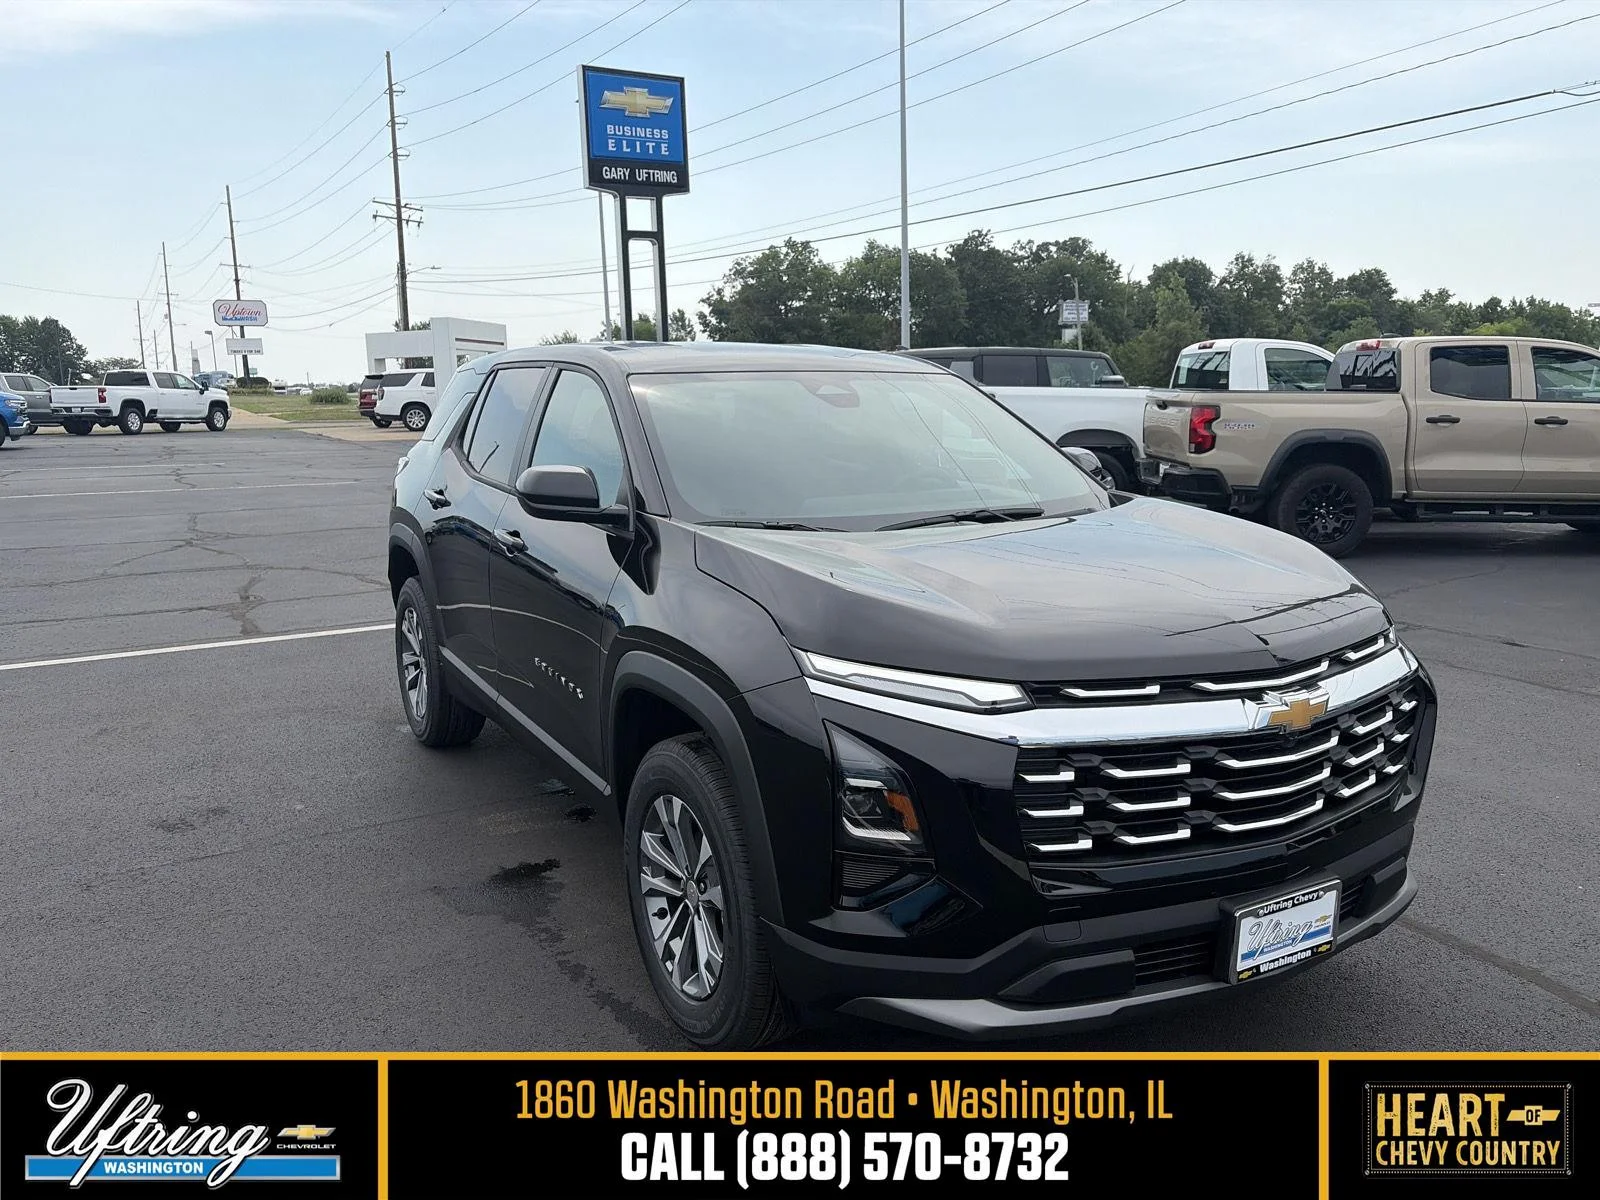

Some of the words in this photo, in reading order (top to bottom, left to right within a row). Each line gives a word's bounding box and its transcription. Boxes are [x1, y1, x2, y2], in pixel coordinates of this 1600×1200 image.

[606, 124, 669, 140] BUSINESS
[608, 139, 669, 155] ELITE
[602, 166, 630, 181] GARY
[635, 168, 678, 183] UFTRING
[217, 302, 262, 317] Uptown
[1263, 899, 1293, 914] Uftring
[1294, 891, 1318, 904] Chevy
[1247, 918, 1313, 960] Uftring
[1259, 949, 1312, 973] Washington
